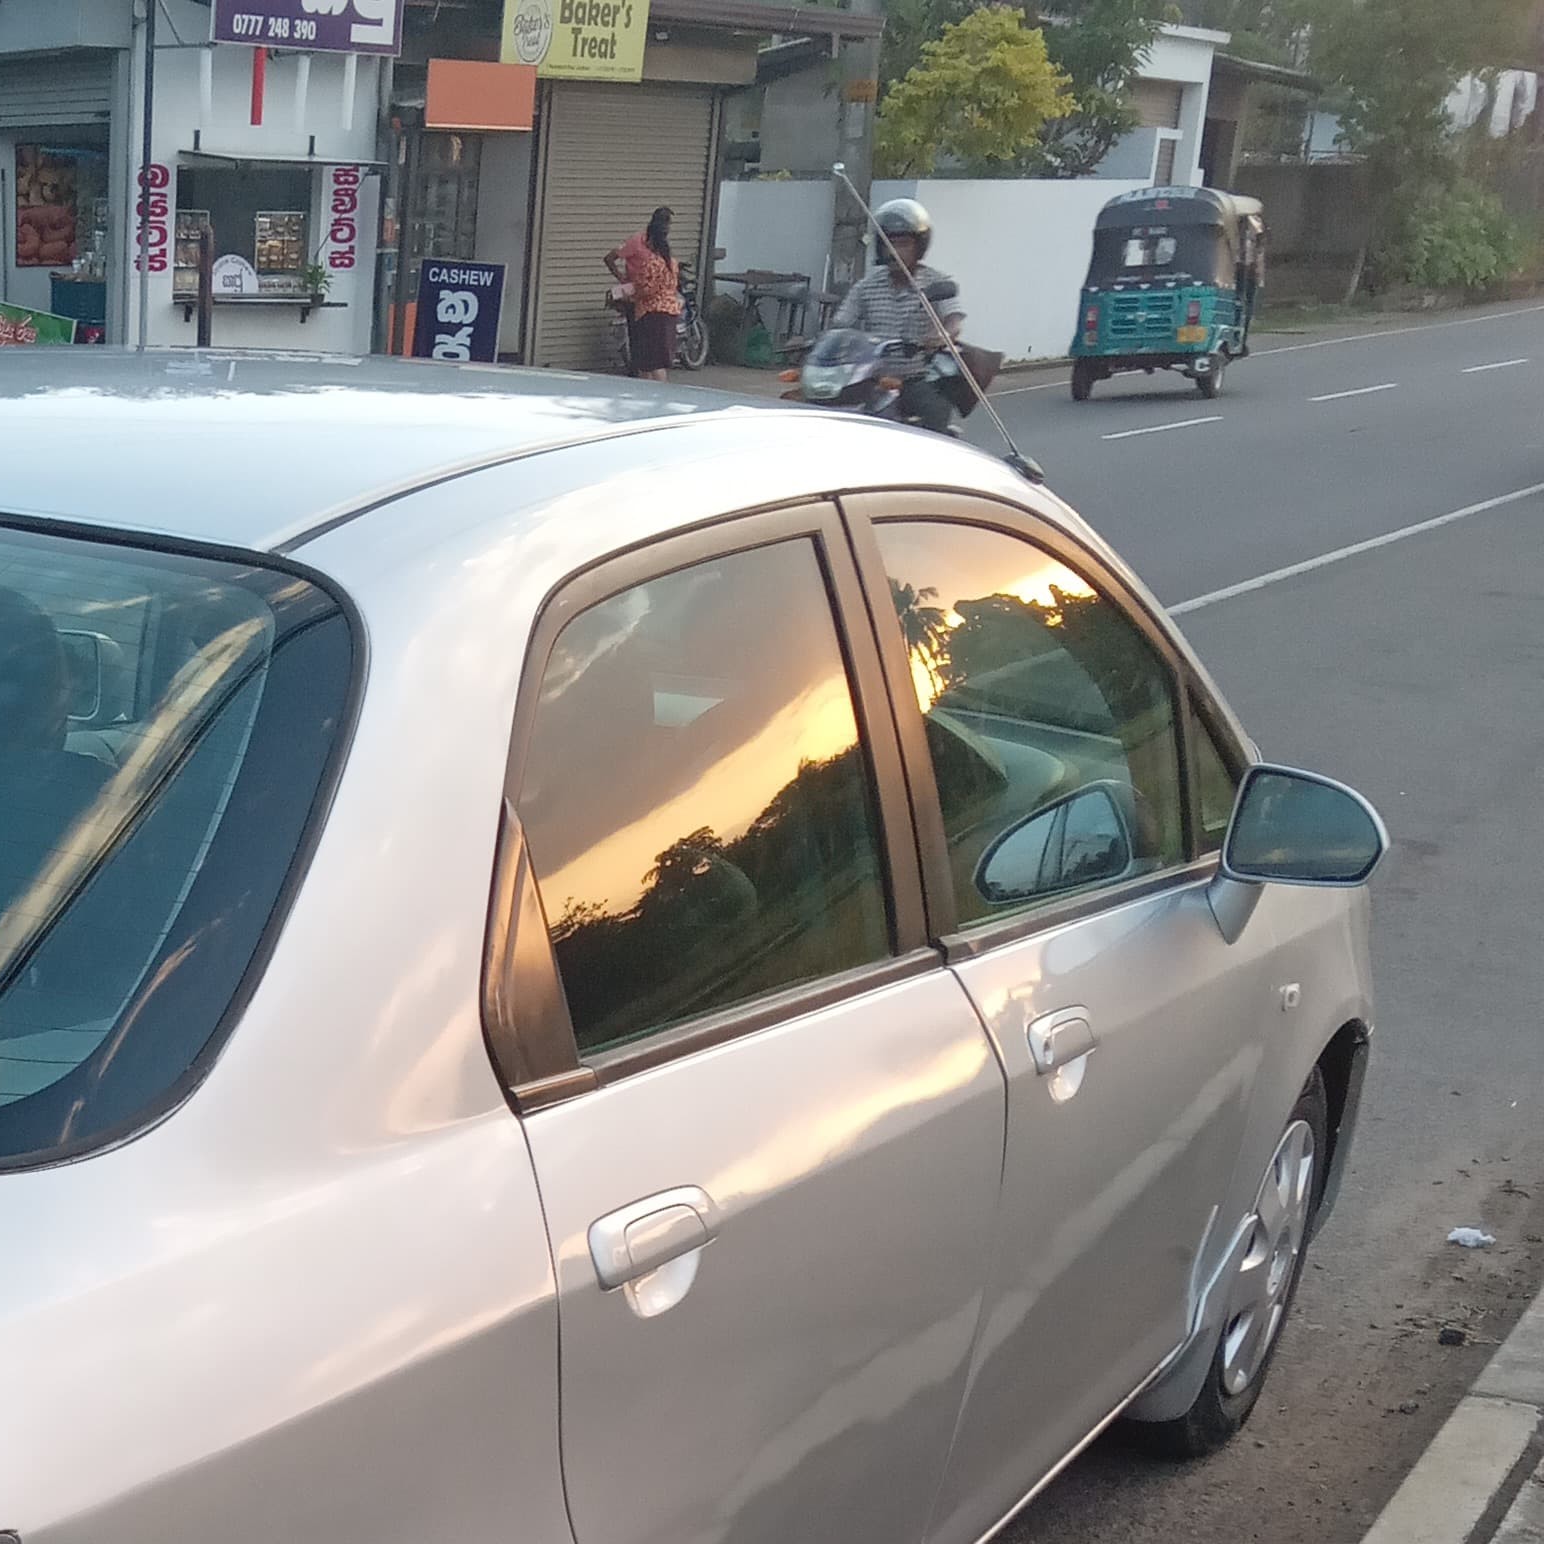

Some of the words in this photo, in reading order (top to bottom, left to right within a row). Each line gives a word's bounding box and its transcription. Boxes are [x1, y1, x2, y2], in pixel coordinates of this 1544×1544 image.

[232, 14, 264, 36] 0777
[268, 16, 290, 38] 248
[293, 20, 316, 41] 390
[560, 0, 633, 29] Baker's
[571, 27, 617, 59] Treat
[428, 267, 494, 287] CASHEW
